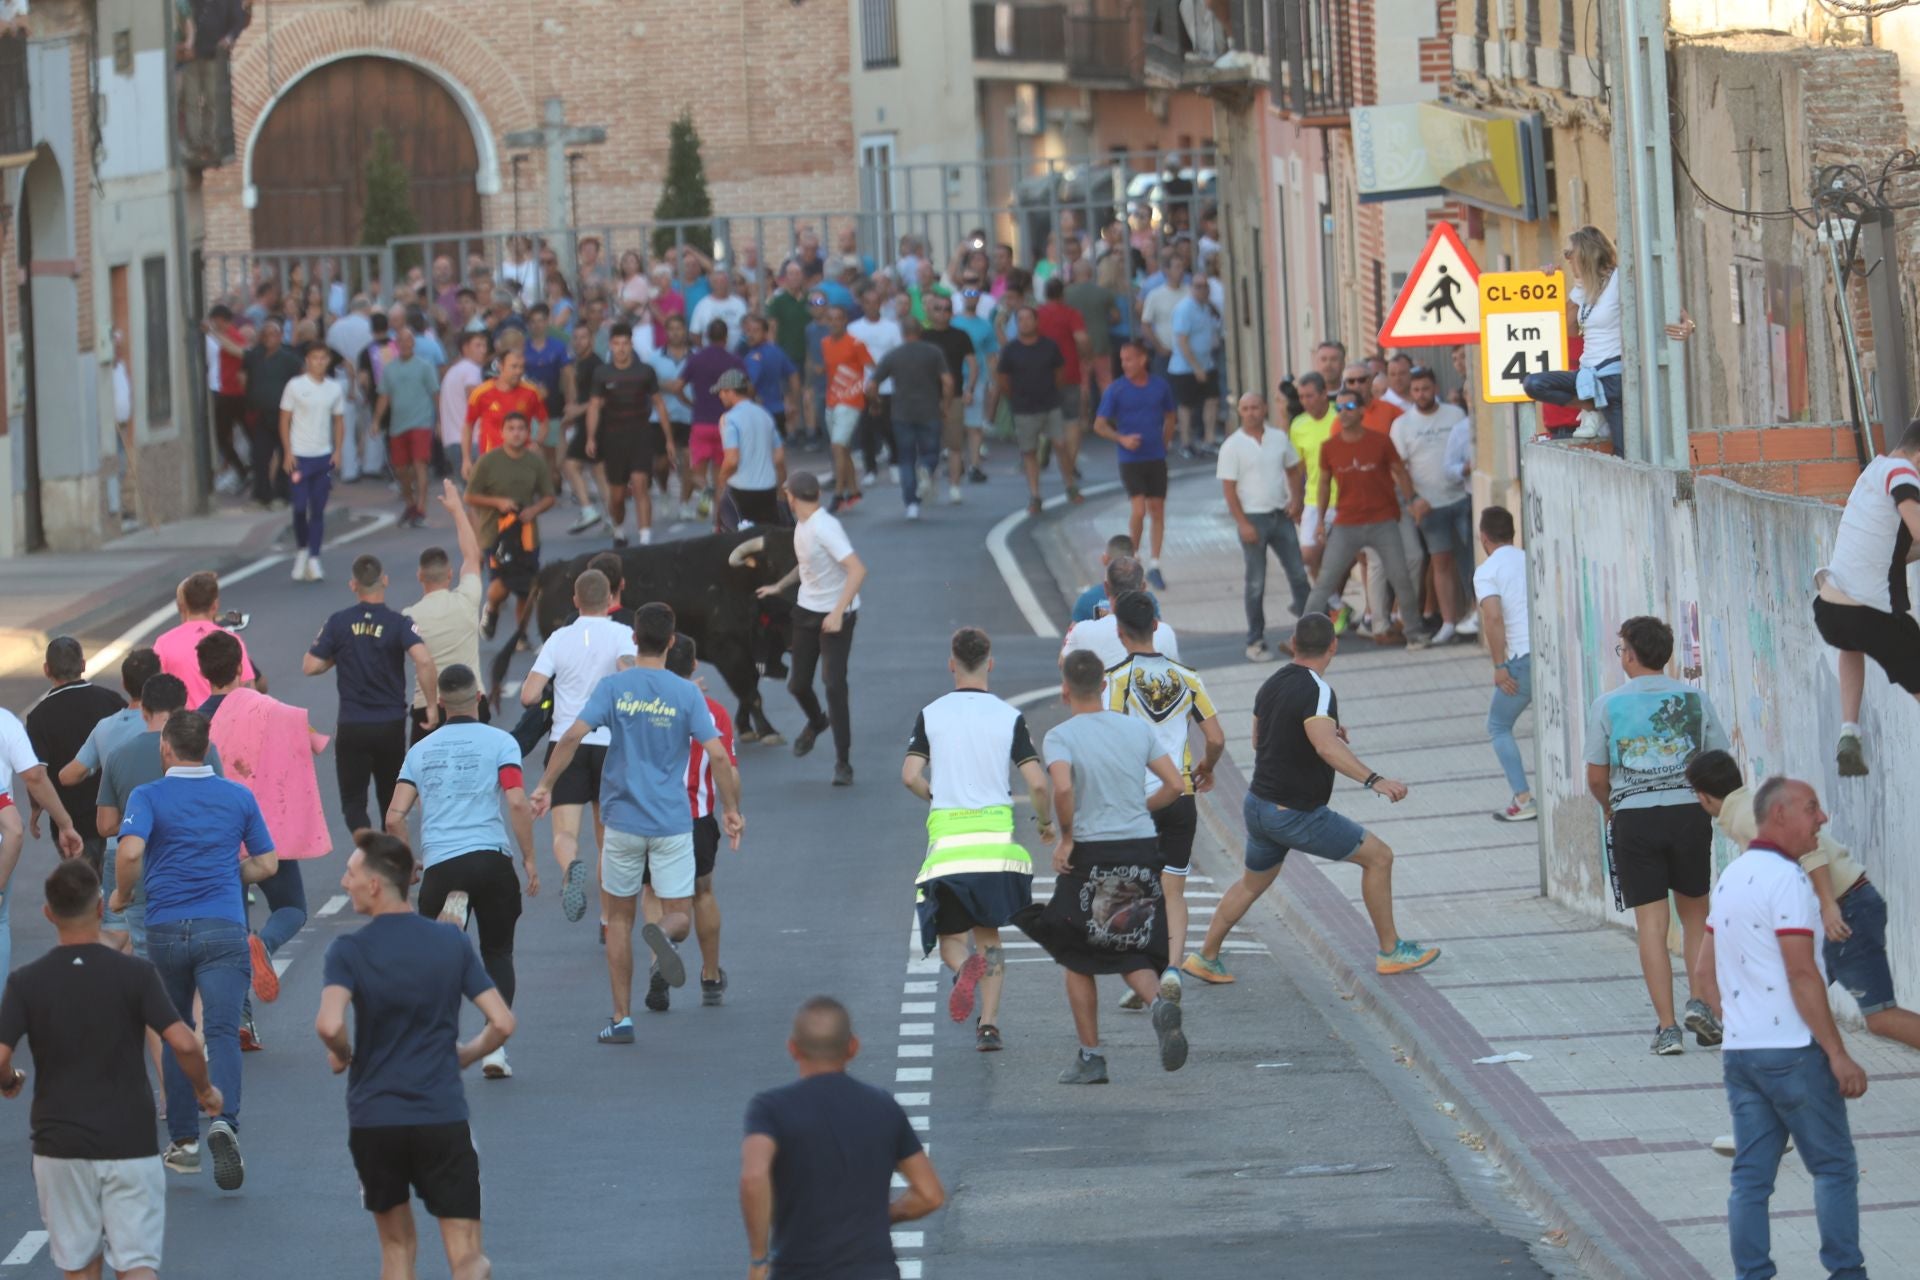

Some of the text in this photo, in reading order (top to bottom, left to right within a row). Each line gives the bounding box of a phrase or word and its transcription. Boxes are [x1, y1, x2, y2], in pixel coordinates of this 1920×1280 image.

[1486, 283, 1558, 302] CL-602
[1506, 323, 1541, 341] km
[1501, 350, 1550, 384] 41
